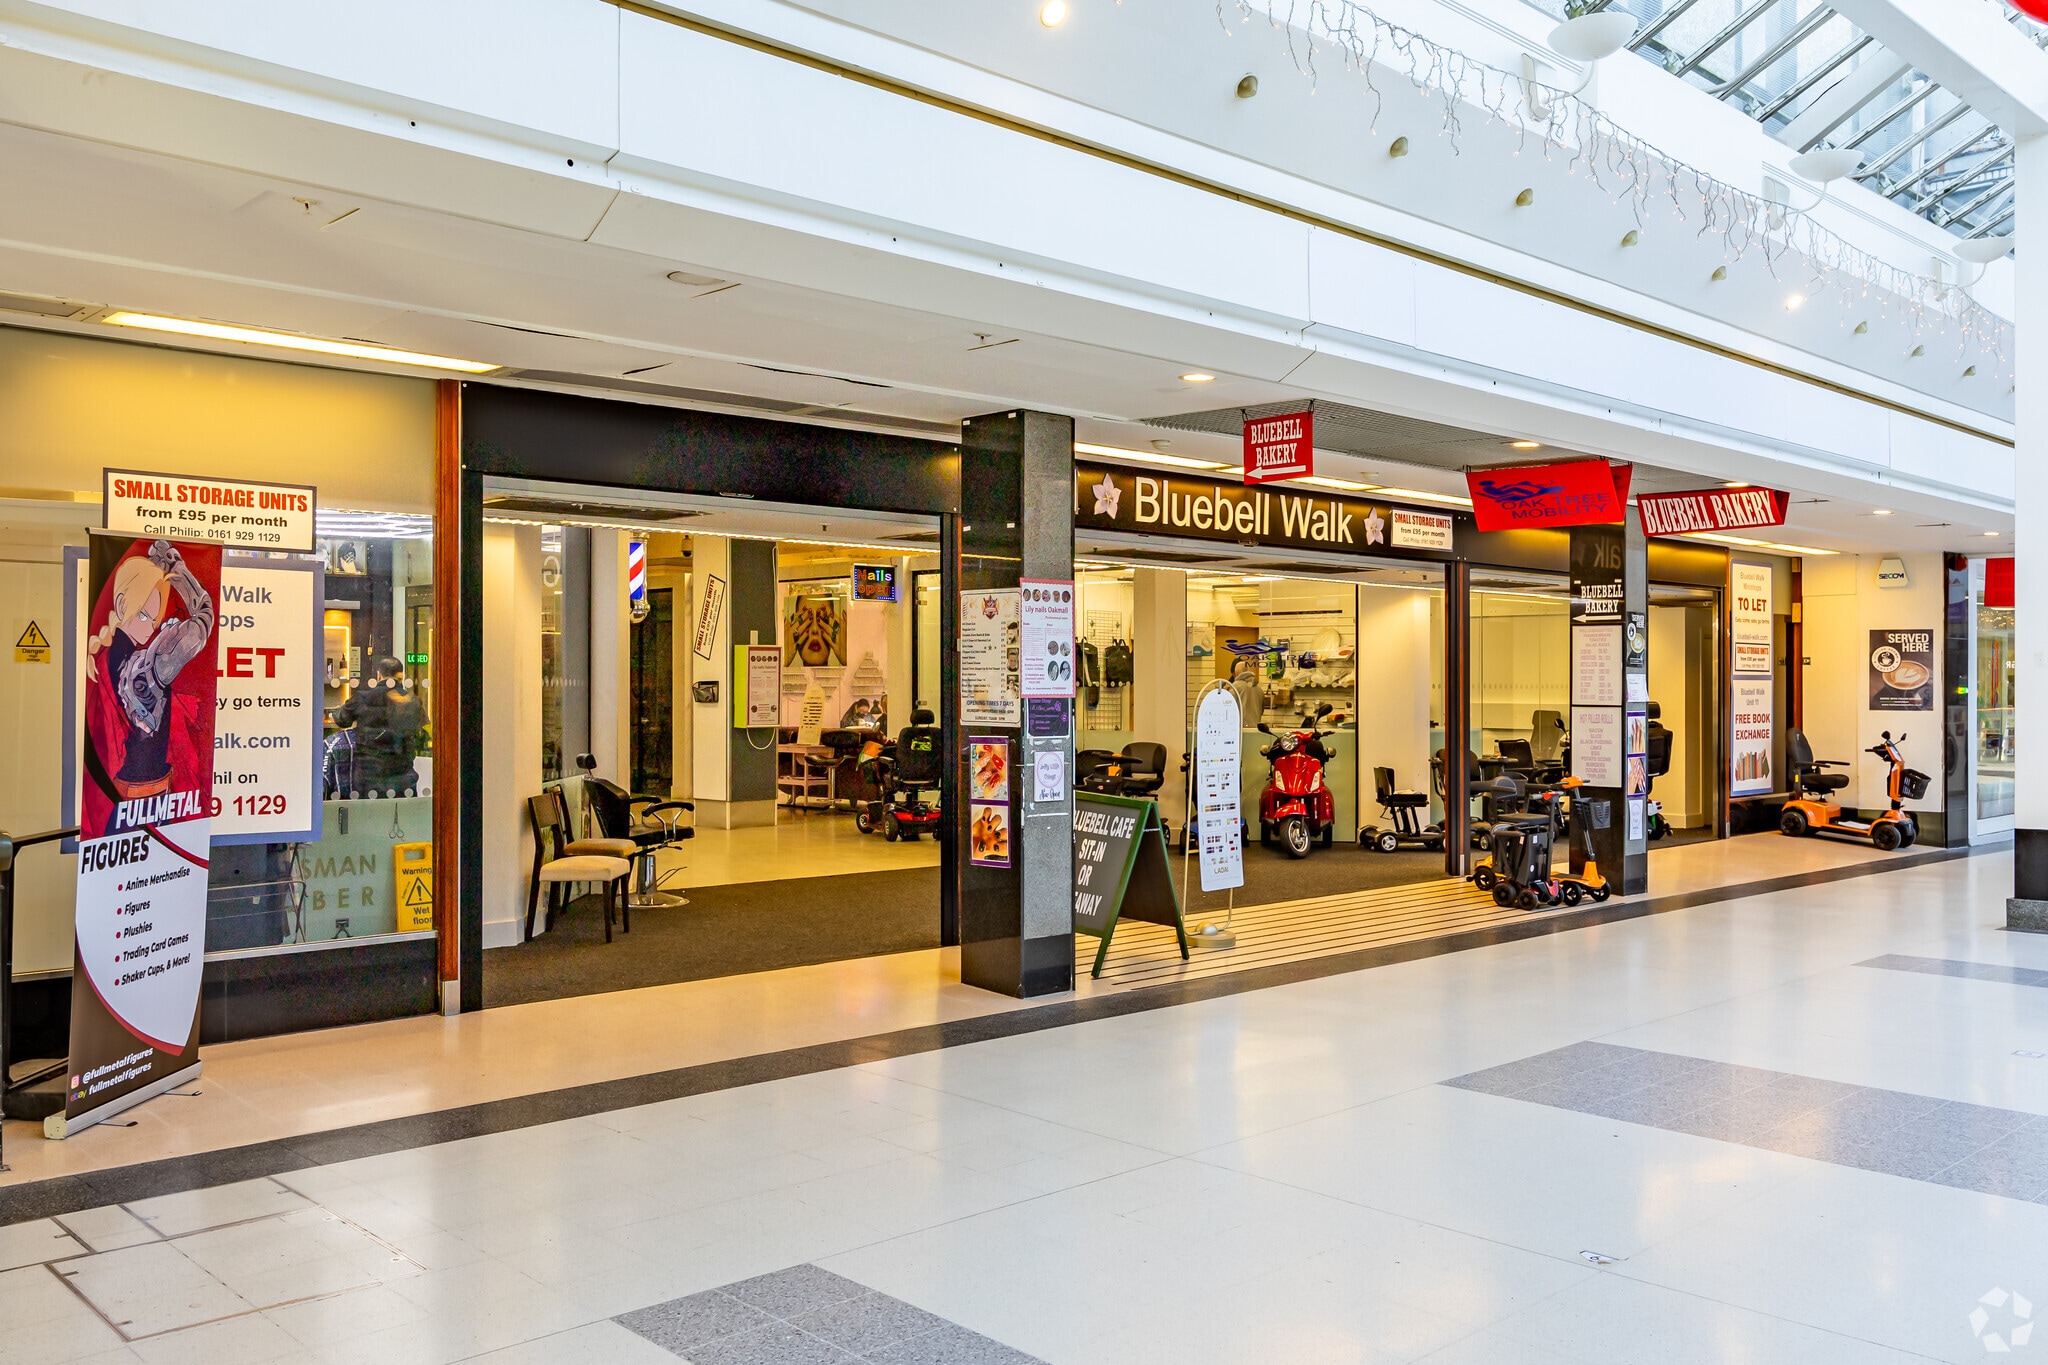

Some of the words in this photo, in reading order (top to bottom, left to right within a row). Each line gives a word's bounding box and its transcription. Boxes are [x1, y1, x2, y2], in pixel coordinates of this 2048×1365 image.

[1251, 419, 1303, 444] BLUEBELL
[1255, 443, 1297, 467] BAKERY
[114, 479, 172, 500] SMALL
[177, 485, 254, 507] STORAGE
[259, 492, 308, 512] UNITS
[1502, 498, 1545, 510] OAK
[1555, 492, 1611, 505] TREE
[136, 506, 172, 519] from
[179, 510, 206, 521] £95
[212, 513, 236, 524] per
[242, 516, 287, 527] month
[1135, 477, 1270, 535] Bluebell
[1280, 495, 1353, 544] Walk
[1395, 513, 1411, 524] SMALL
[1412, 515, 1434, 527] STORAGE
[1436, 518, 1450, 529] UNITS
[1512, 504, 1607, 519] MOBILITY
[1642, 495, 1714, 535] BLUEBELL
[1717, 490, 1776, 528] BAKERY
[144, 525, 165, 534] Call
[170, 526, 204, 537] Philip:
[208, 529, 231, 539] 0161
[236, 531, 254, 540] 929
[258, 533, 280, 542] 1129
[858, 569, 892, 581] Nails
[222, 586, 272, 603] Walk
[858, 584, 890, 596] open
[1581, 585, 1623, 598] BLUEBELL
[701, 601, 710, 629] STORAGE
[1585, 600, 1619, 613] BAKERY
[1738, 598, 1749, 610] TO
[1752, 599, 1766, 612] LET
[1888, 633, 1929, 643] SERVED
[1902, 643, 1929, 652] HERE
[217, 647, 285, 678] ET
[233, 698, 252, 710] go
[258, 696, 301, 707] terms
[1735, 714, 1750, 724] FREE
[1753, 713, 1770, 723] BOOK
[1736, 729, 1770, 740] EXCHANGE
[238, 774, 258, 784] on
[115, 789, 202, 829] FULLMETAL
[233, 795, 286, 816] 1129
[1074, 810, 1110, 835] LUEBELL
[1110, 816, 1135, 839] CAFE
[81, 834, 150, 874] FIGURES
[1079, 838, 1107, 862] SIT-IN
[300, 854, 376, 879] SMAN
[1078, 864, 1092, 886] OR
[125, 877, 148, 891] Anime
[150, 866, 190, 886] Merchandise
[124, 900, 150, 915] Figures
[1075, 891, 1102, 916] AWAY
[124, 921, 152, 938] Plushies
[123, 946, 150, 962] Trading
[151, 938, 166, 953] Card
[167, 933, 189, 949] Games
[122, 968, 146, 986] Shaker
[148, 961, 165, 976] Cups,
[166, 959, 171, 967] &
[172, 953, 191, 967] More!
[82, 1048, 153, 1084] @fullmetalfigures
[70, 1089, 87, 1102] ebay
[89, 1062, 152, 1095] fullmetalfigures
